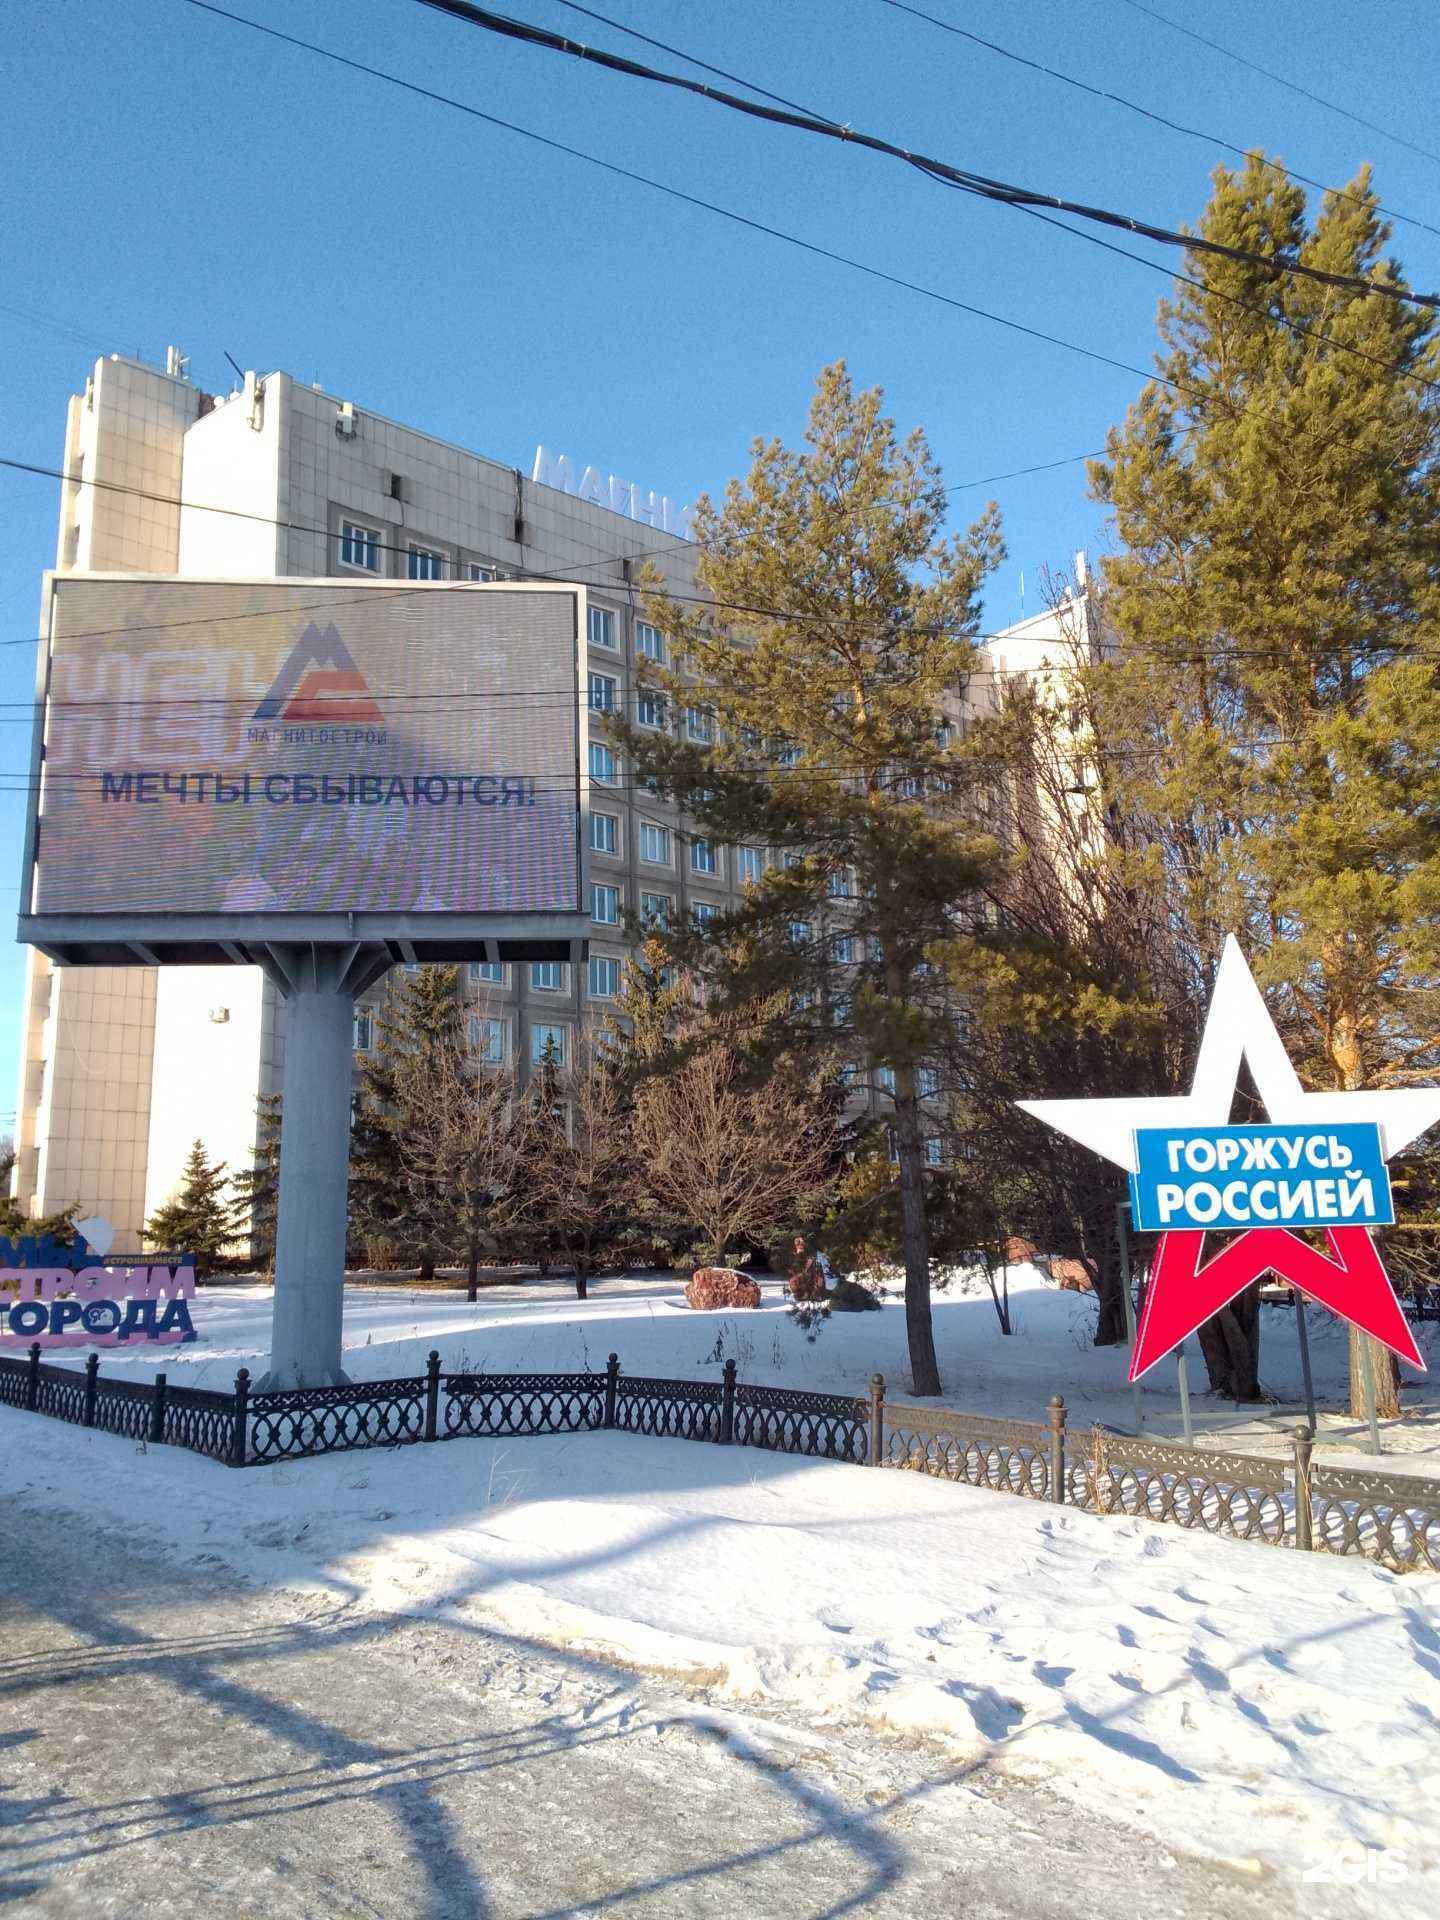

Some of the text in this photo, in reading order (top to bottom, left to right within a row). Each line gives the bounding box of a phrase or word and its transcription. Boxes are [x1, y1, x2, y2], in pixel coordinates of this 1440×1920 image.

[102, 771, 535, 807] МЕЧТЫ СБЫВАЮТСЯ!
[1167, 1135, 1353, 1173] ГОРЖУСЬ
[1156, 1169, 1377, 1223] РОССИЕЙ
